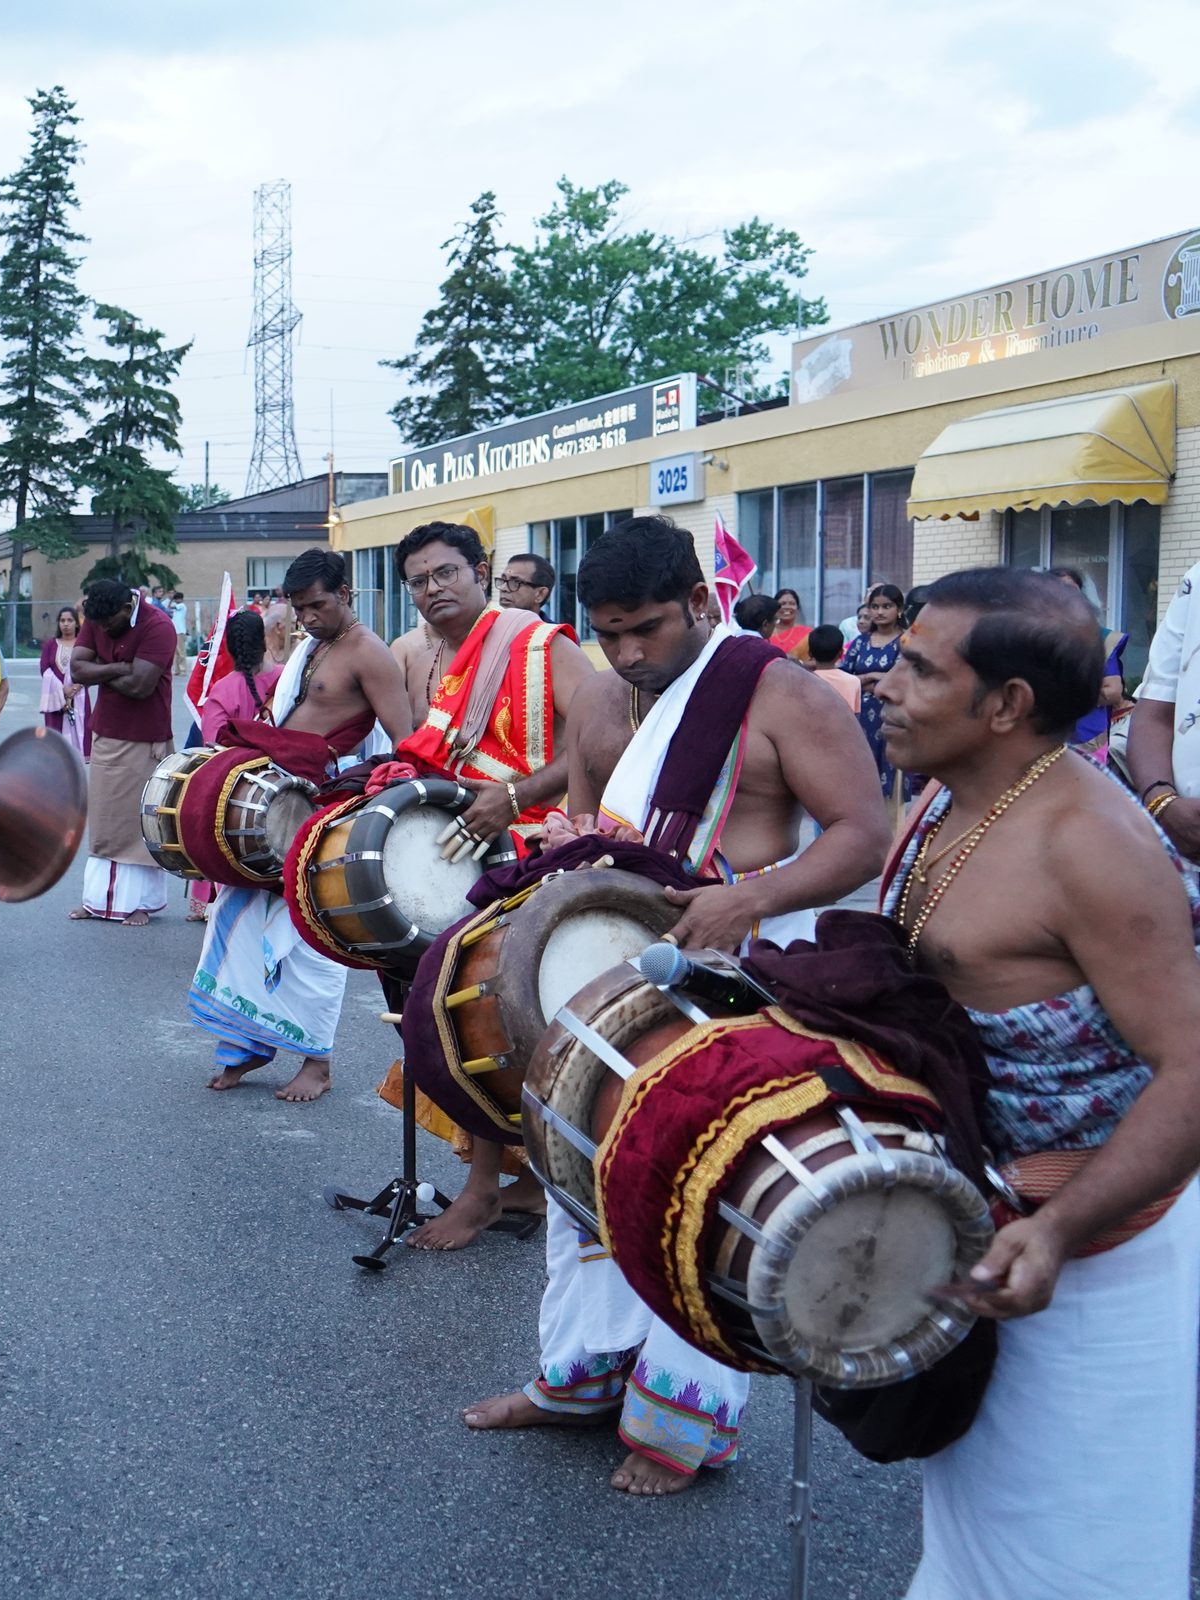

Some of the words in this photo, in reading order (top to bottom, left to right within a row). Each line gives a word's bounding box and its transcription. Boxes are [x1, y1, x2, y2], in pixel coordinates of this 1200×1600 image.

[878, 289, 1015, 361] WONDER
[1024, 254, 1140, 326] HOME
[979, 340, 995, 364] &
[578, 427, 626, 455] 350-1618
[411, 459, 437, 491] ONE
[443, 452, 475, 484] PLUS
[478, 434, 550, 477] KITCHENS
[658, 466, 688, 495] 3025
